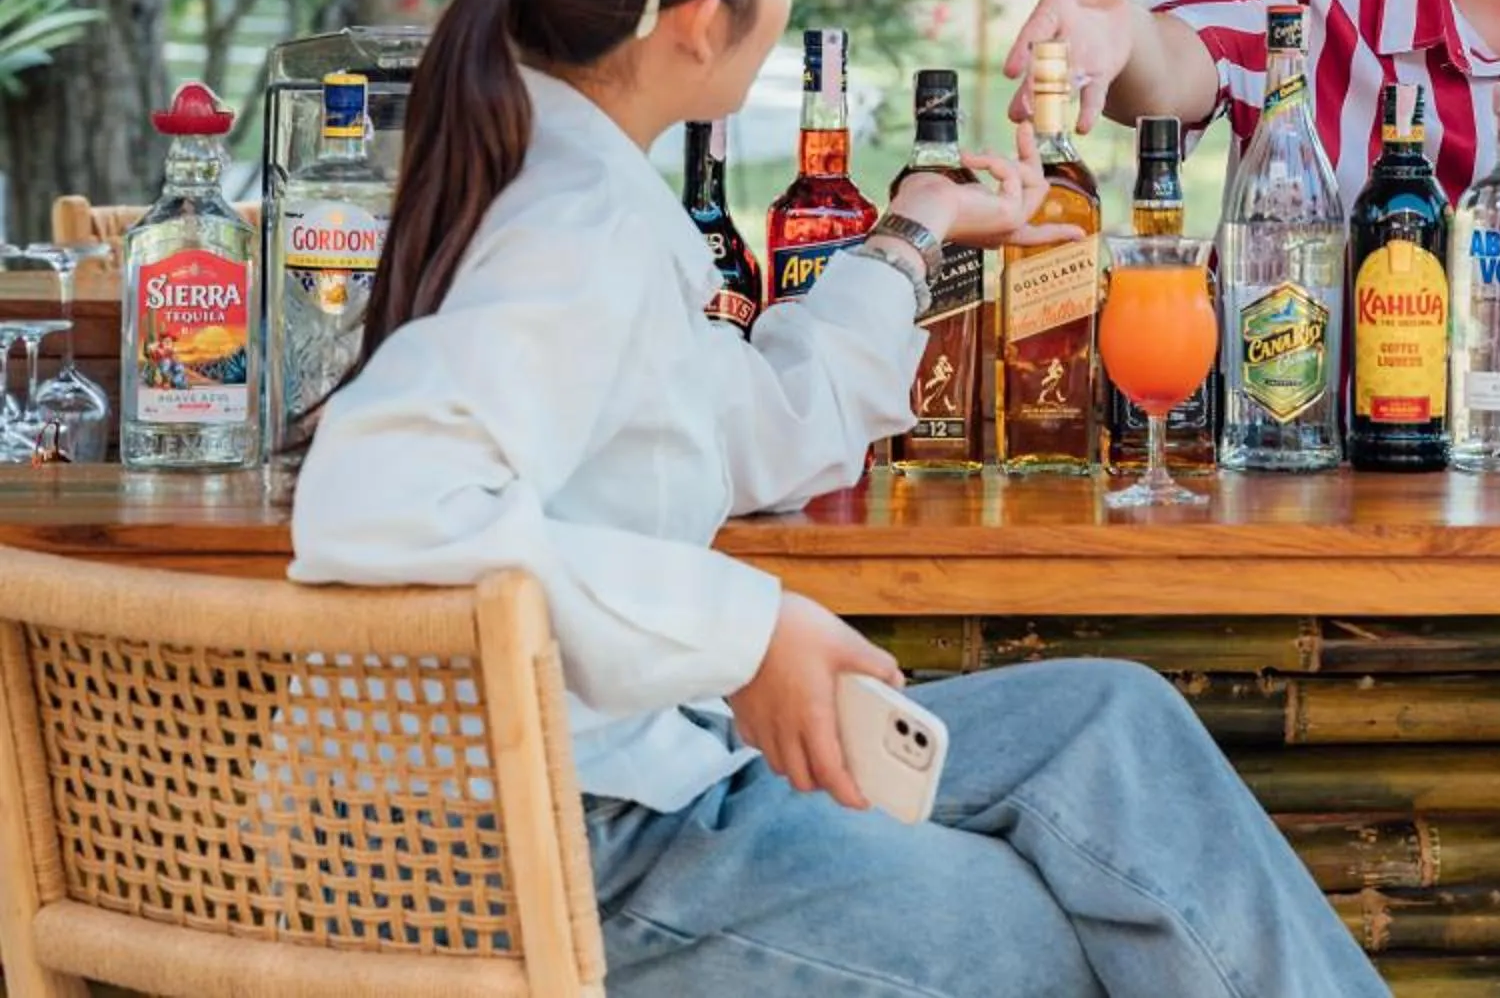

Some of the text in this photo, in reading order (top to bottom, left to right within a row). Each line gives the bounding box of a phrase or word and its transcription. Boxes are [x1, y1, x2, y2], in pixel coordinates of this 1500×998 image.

[145, 274, 241, 309] SIERRA
[1013, 272, 1049, 294] GOLD
[1051, 258, 1094, 280] LABEL
[164, 311, 225, 322] TEQUILA
[1359, 287, 1443, 325] KAHLÚA
[929, 421, 948, 437] 12
